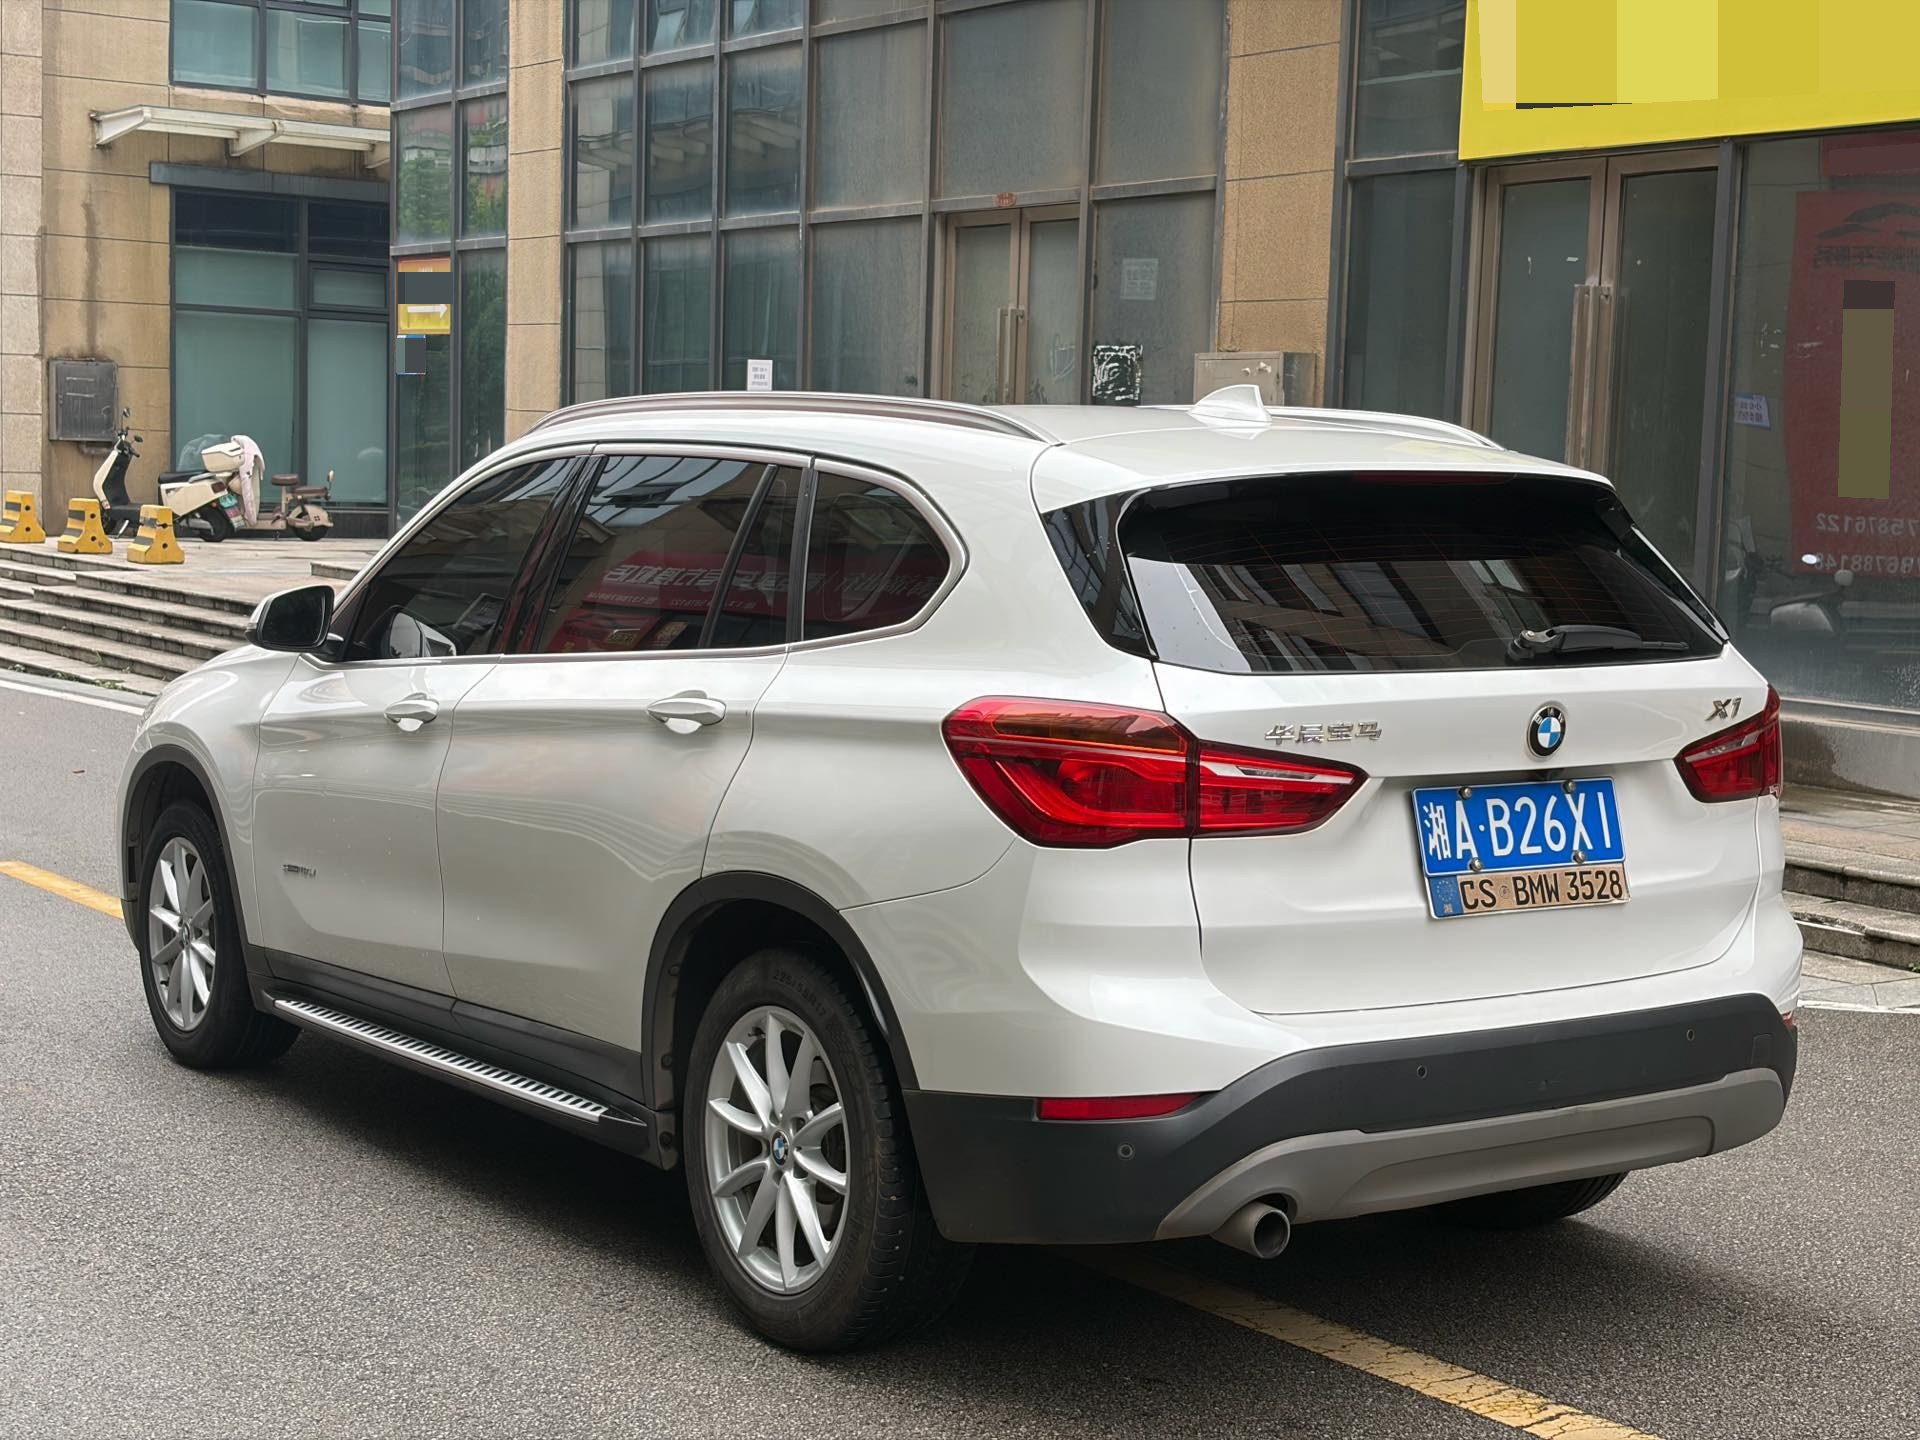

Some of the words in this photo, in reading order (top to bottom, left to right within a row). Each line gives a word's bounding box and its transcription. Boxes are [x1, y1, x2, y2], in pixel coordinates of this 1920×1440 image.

[1705, 698, 1742, 721] X1
[1264, 721, 1383, 745] 华晨宝马
[1459, 879, 1497, 909] CS
[1512, 873, 1560, 905] BMW
[1564, 869, 1624, 902] 3528
